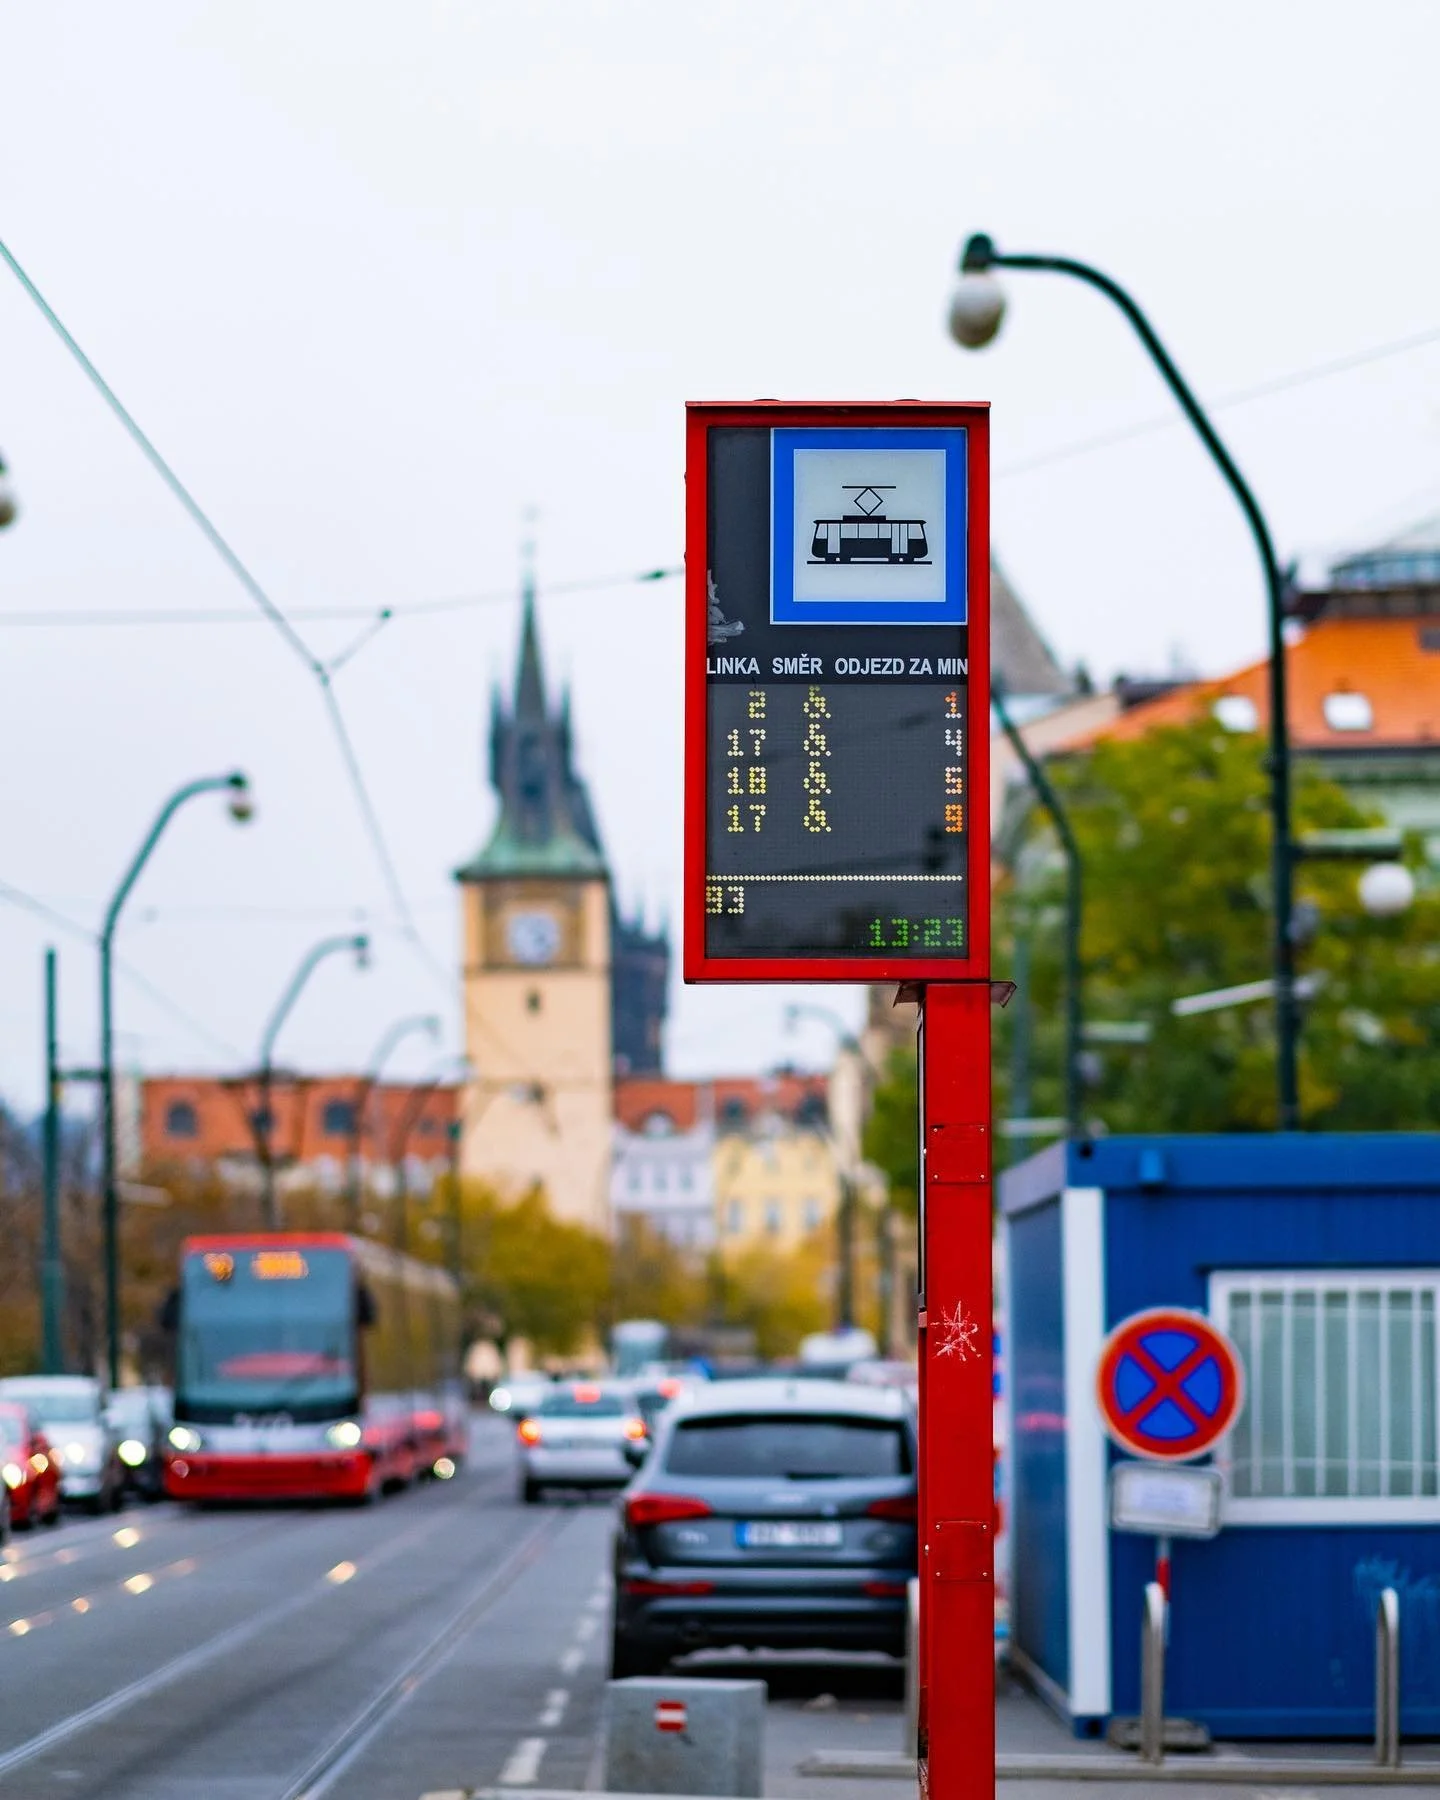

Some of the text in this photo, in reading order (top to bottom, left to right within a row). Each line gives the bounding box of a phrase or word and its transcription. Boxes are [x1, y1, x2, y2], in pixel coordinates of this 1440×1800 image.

[706, 654, 968, 675] LINKA SMĚR ODJEZD ZA MIN
[749, 690, 962, 718] 2 1
[727, 729, 962, 757] 17 4
[727, 767, 962, 795] 18 5
[727, 804, 963, 833] 17 9
[706, 886, 744, 914] 93
[869, 918, 963, 947] 13:23
